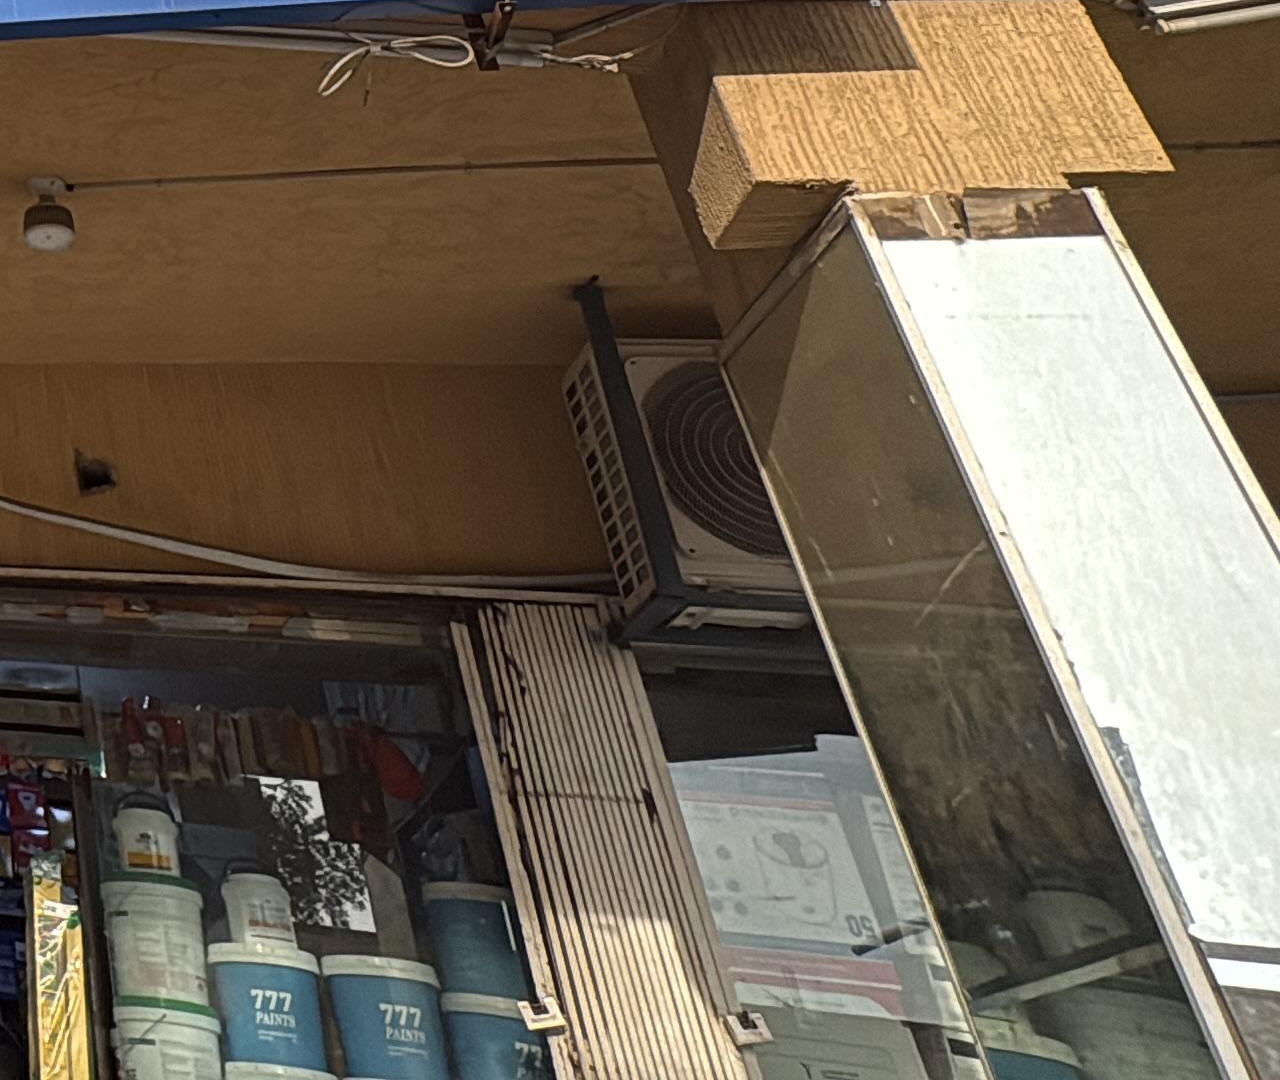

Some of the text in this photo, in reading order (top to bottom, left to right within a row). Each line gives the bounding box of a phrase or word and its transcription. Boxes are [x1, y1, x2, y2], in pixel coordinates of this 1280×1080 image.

[250, 989, 292, 1012] 777
[256, 1011, 296, 1028] PAINTS
[378, 1003, 421, 1028] 777
[386, 1026, 426, 1044] PAINTS
